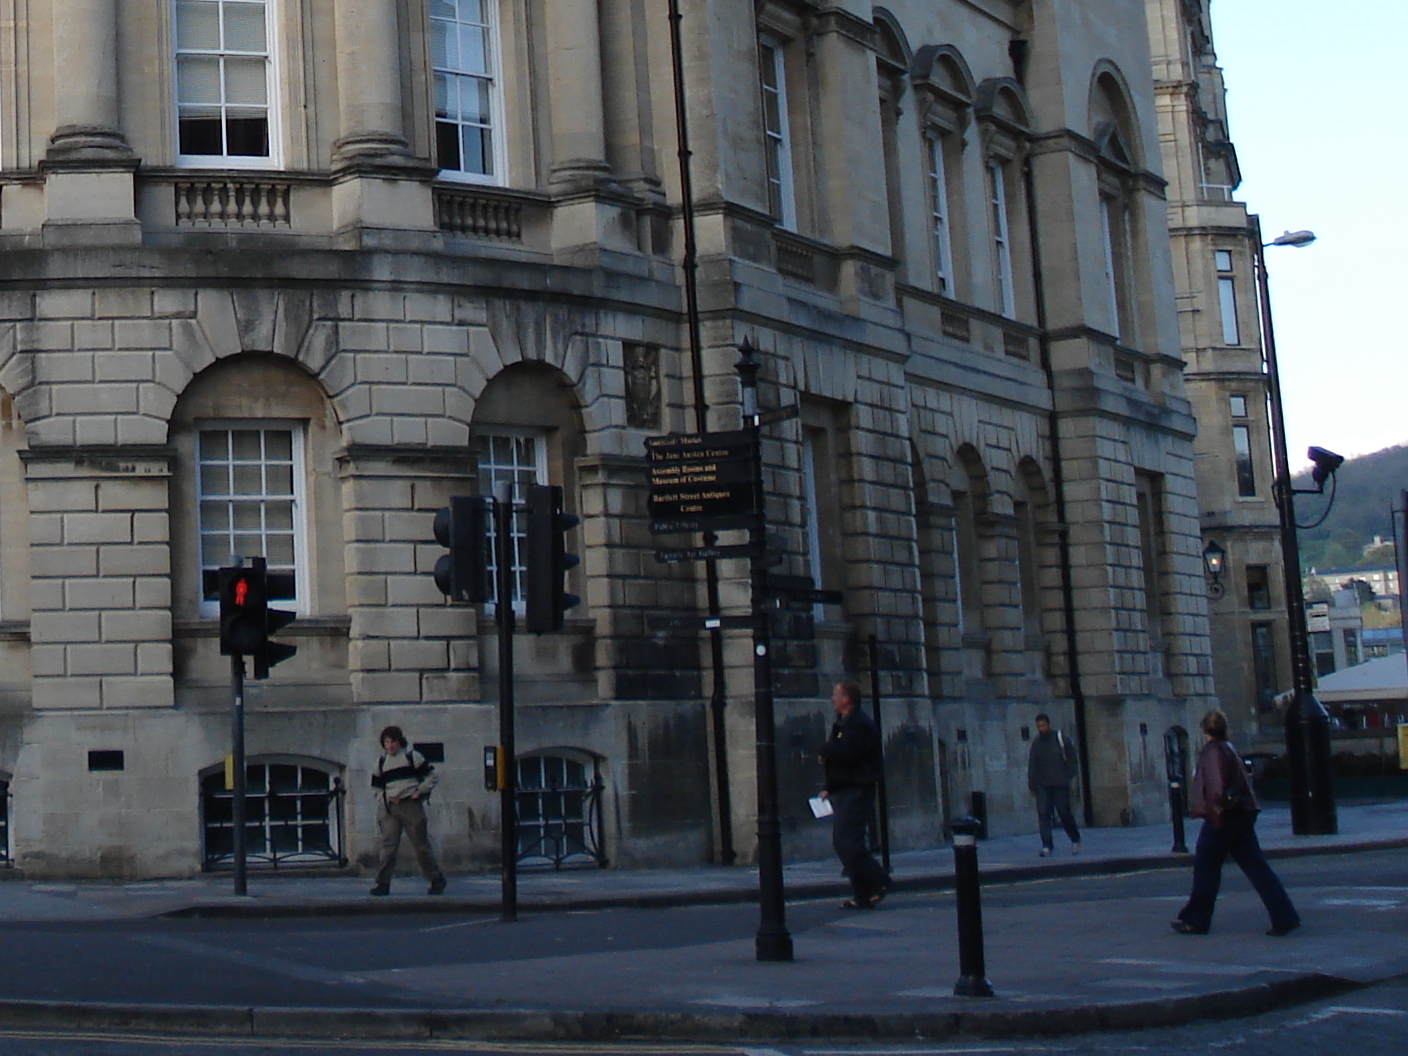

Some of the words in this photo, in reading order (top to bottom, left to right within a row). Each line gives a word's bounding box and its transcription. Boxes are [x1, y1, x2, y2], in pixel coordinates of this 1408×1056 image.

[652, 450, 664, 460] The
[706, 449, 729, 457] Centre
[652, 467, 681, 476] Assembly
[682, 465, 703, 473] Rooms
[705, 463, 717, 472] and
[652, 477, 679, 485] Museum
[680, 475, 687, 483] of
[688, 474, 717, 483] Costume
[653, 494, 679, 502] Bartlett
[679, 492, 701, 500] Street
[702, 491, 730, 499] Antiques
